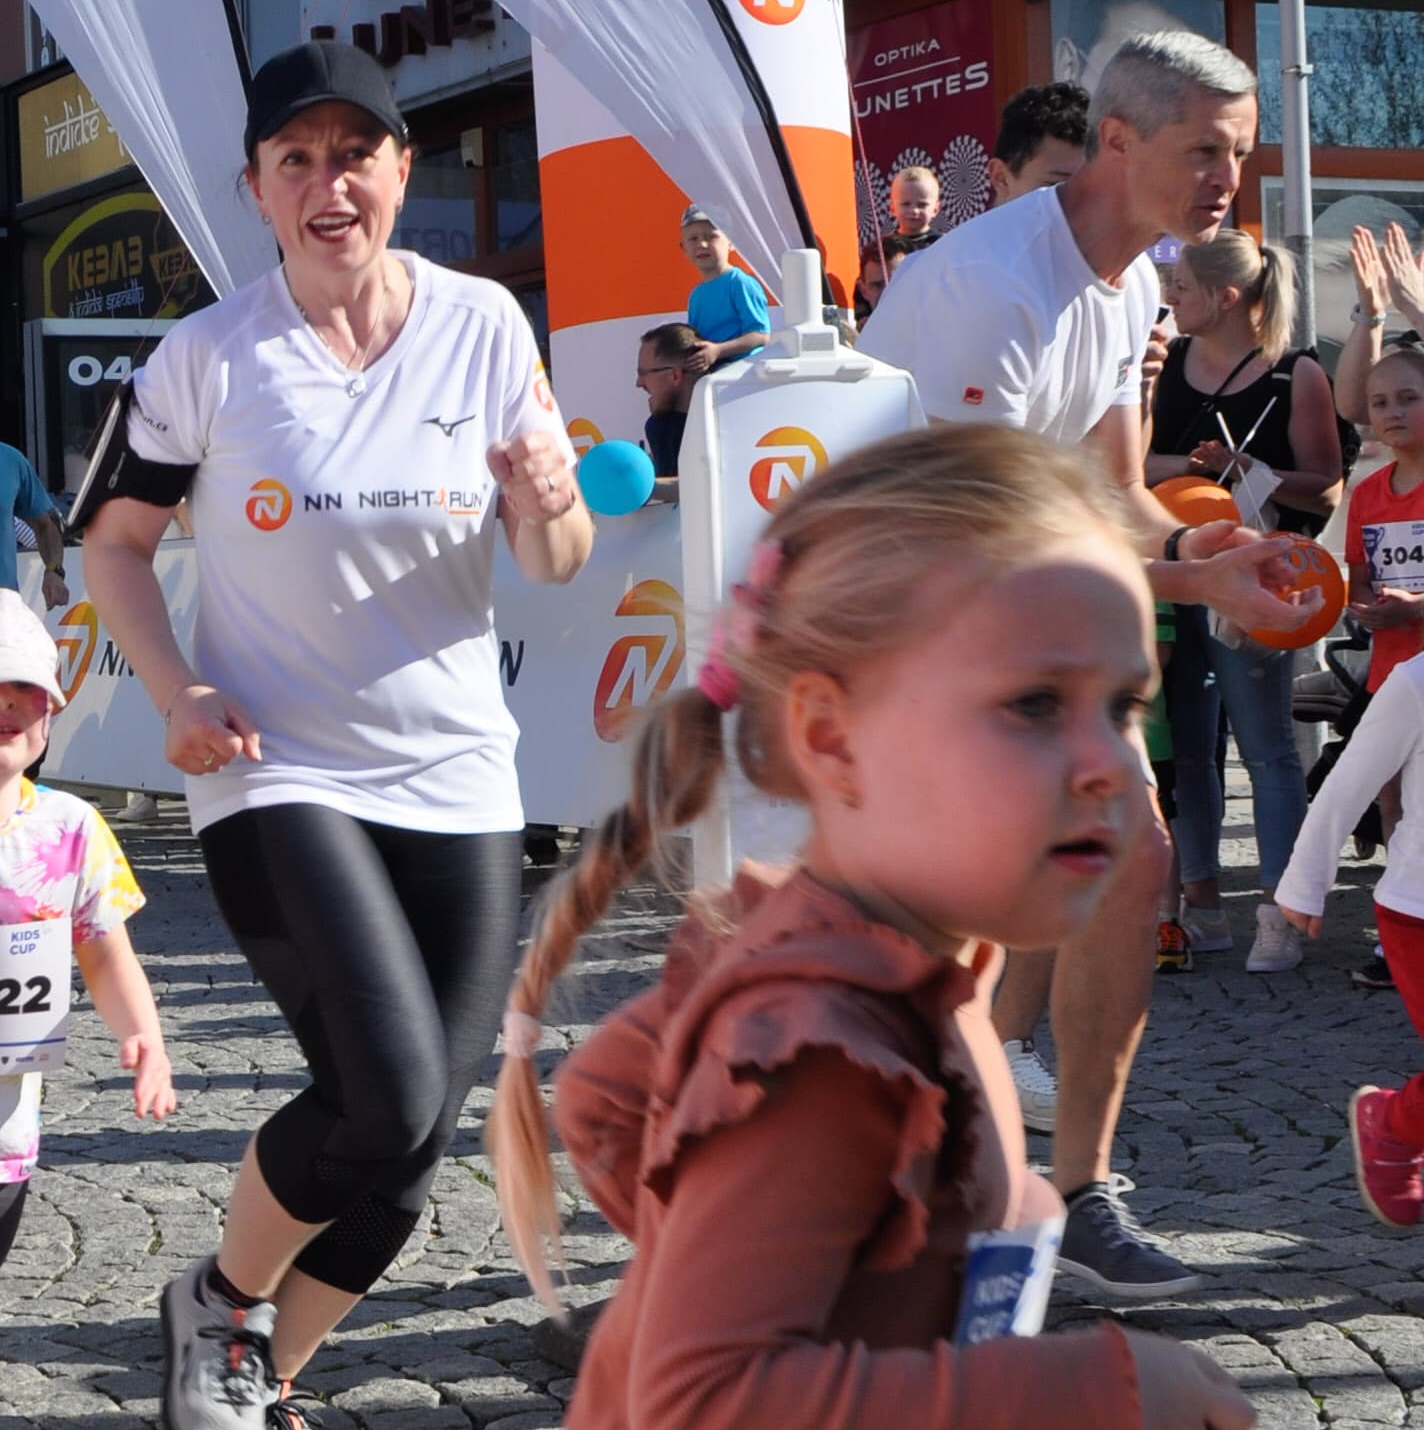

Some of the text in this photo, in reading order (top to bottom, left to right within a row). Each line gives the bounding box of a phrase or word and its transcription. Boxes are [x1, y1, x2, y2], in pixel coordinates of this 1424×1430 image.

[874, 38, 941, 67] OPTIKA
[854, 61, 990, 118] UNETTES
[304, 488, 483, 513] NN NIGHT RUN
[11, 928, 41, 942] KIDS
[9, 942, 37, 956] CUP
